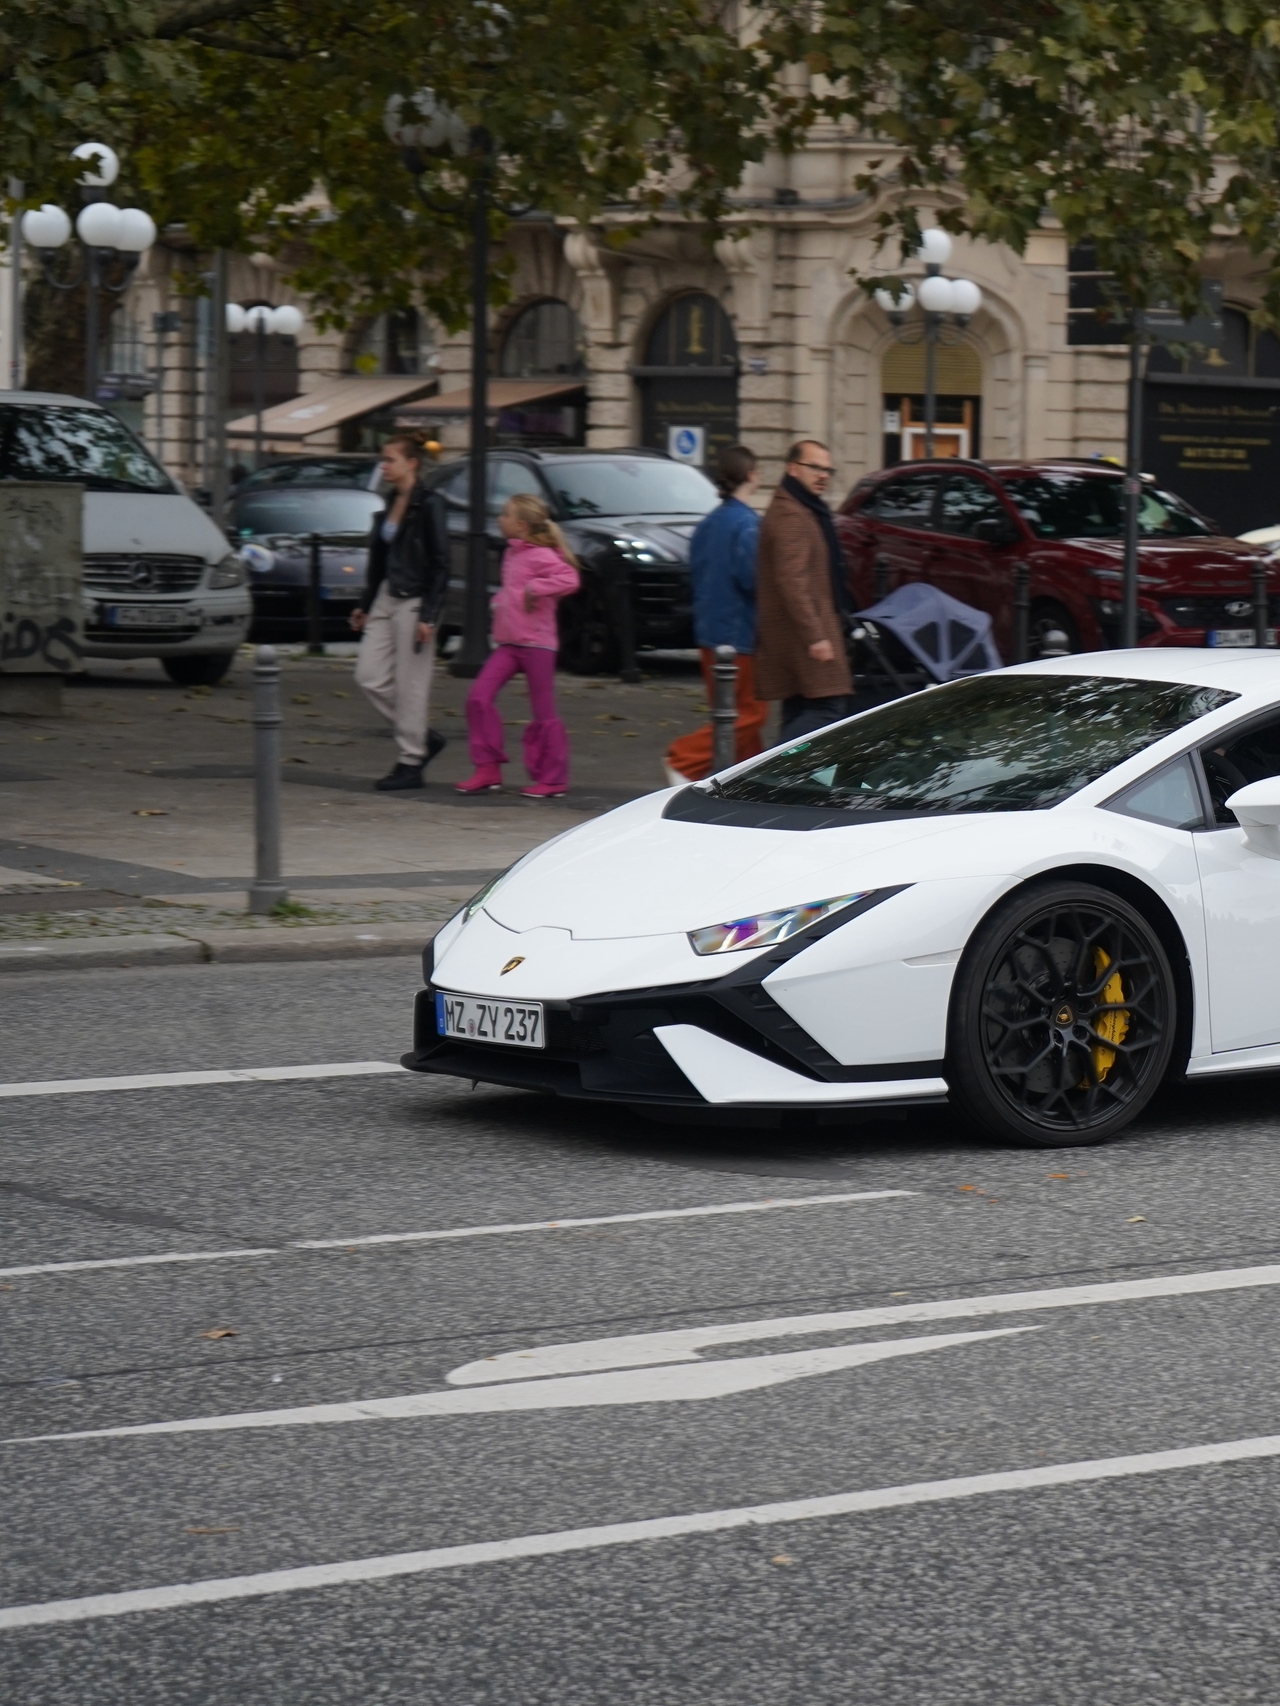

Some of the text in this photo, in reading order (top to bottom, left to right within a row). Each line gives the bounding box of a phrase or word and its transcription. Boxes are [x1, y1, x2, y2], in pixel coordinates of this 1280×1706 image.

[445, 1000, 540, 1043] MZ ZY 237
